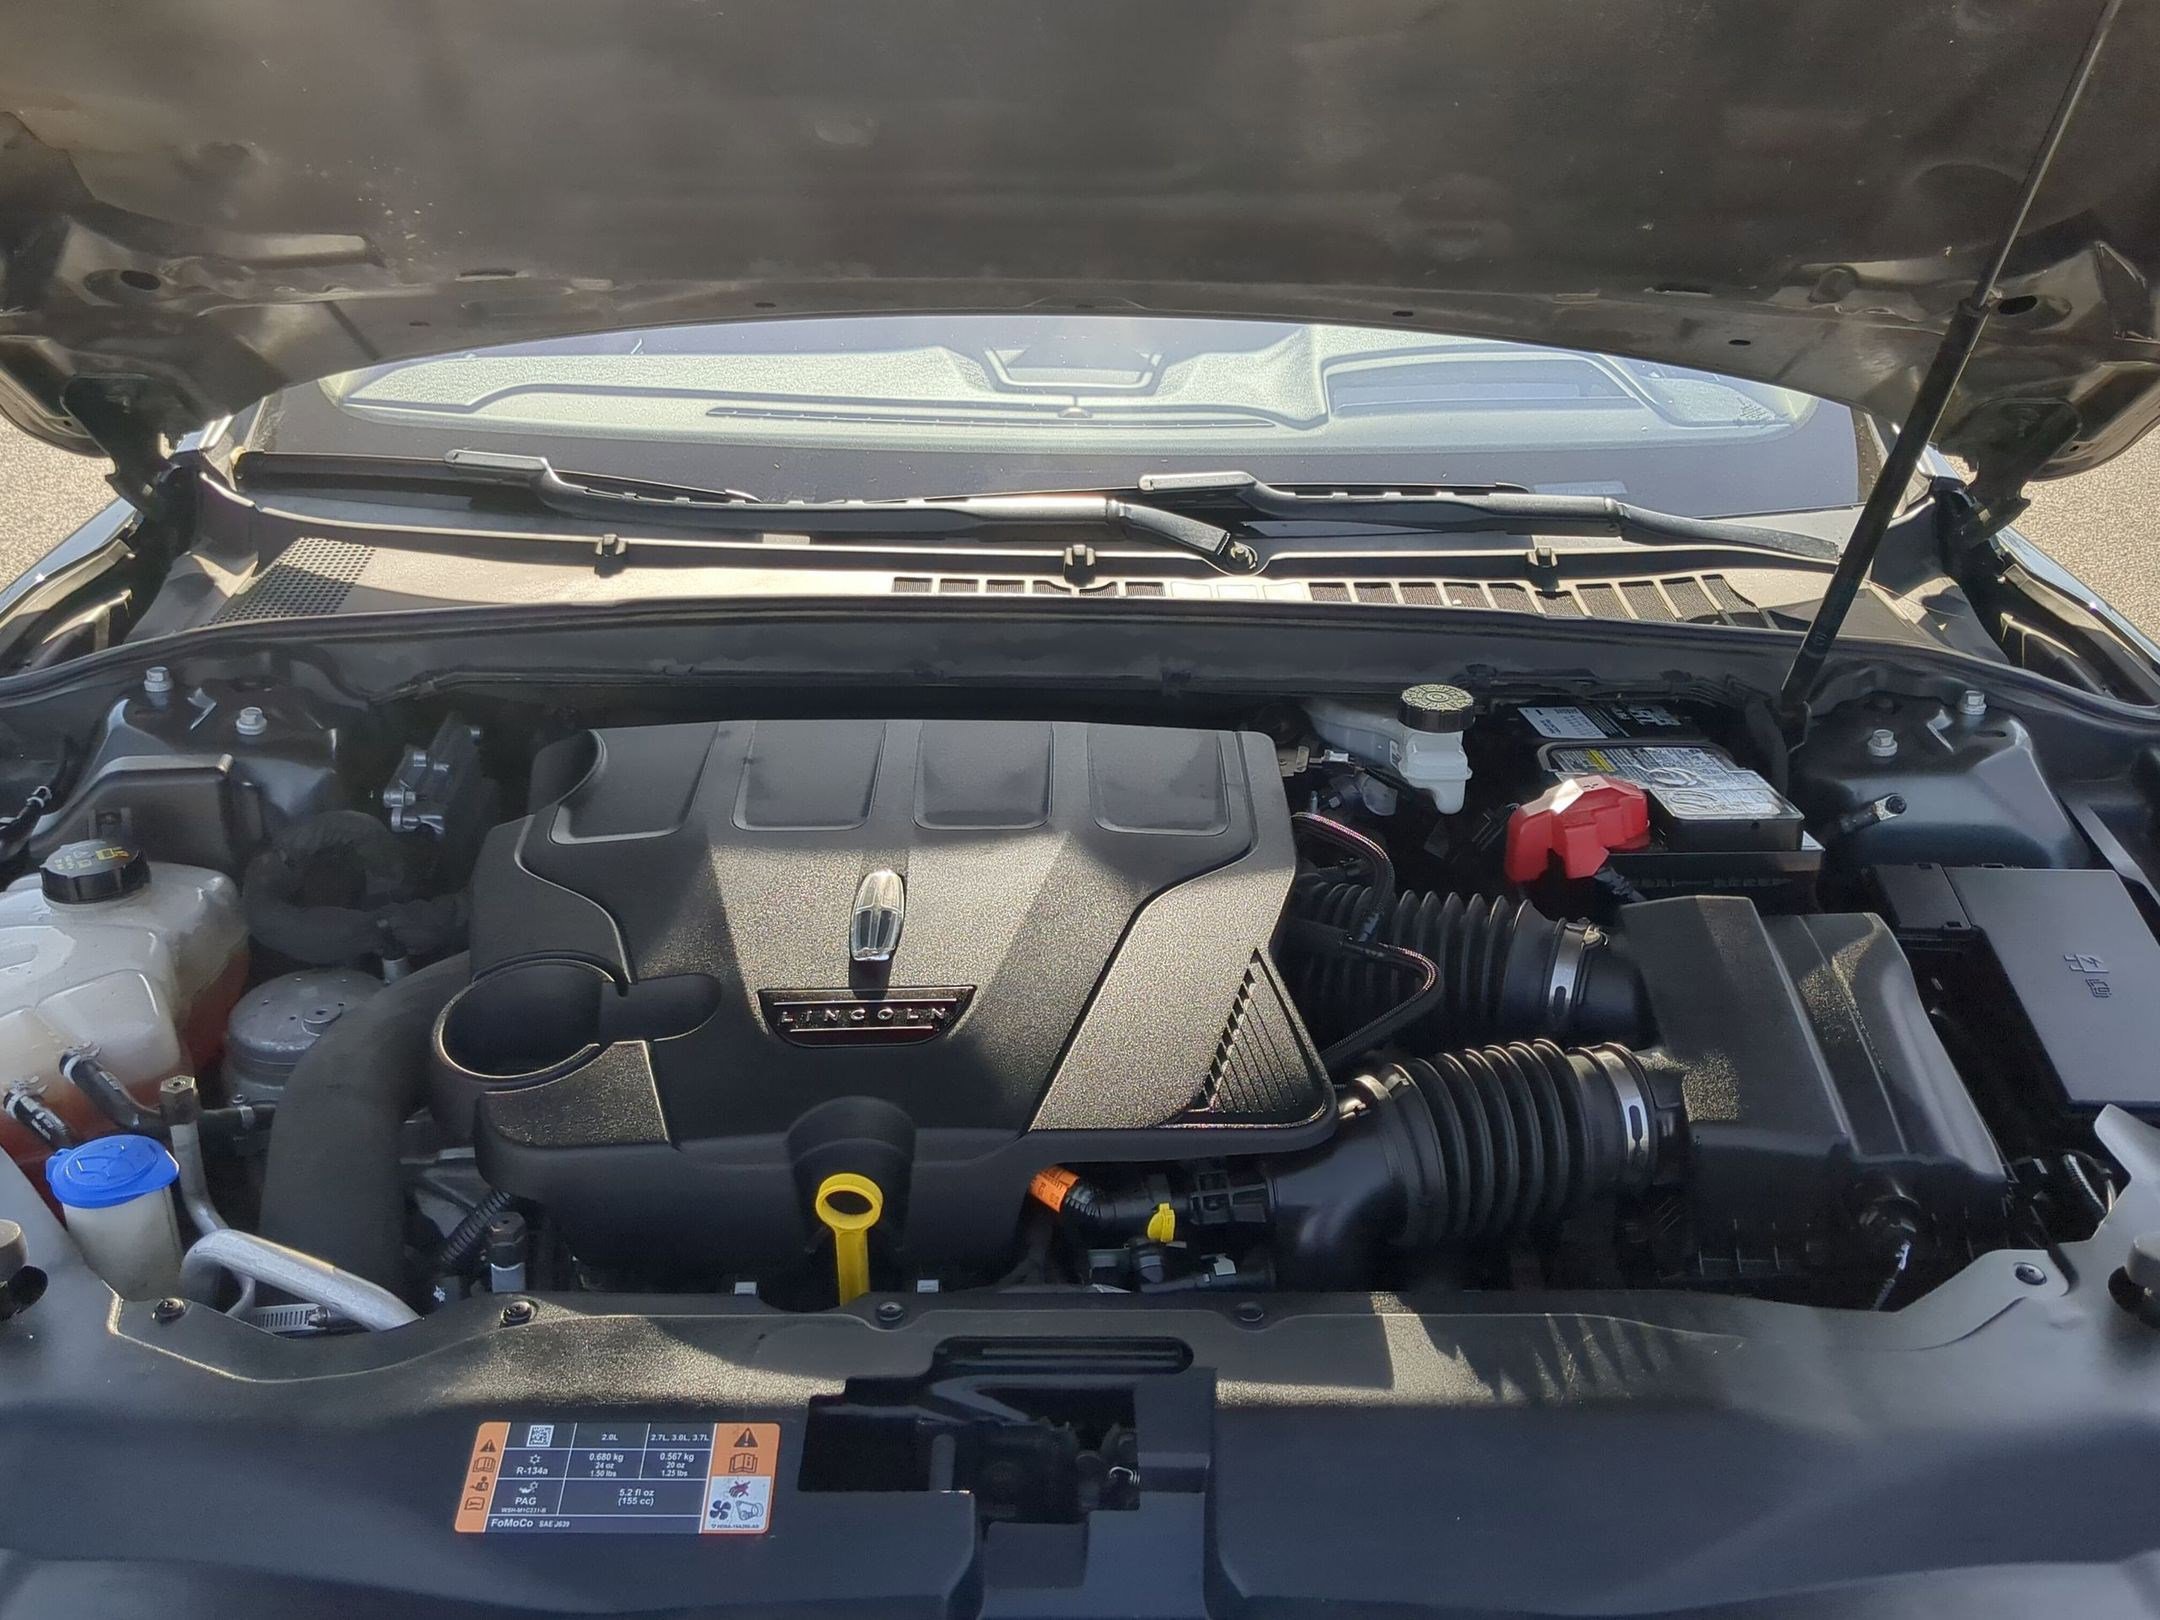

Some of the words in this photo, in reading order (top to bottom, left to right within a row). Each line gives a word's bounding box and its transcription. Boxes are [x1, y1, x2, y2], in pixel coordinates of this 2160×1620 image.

[781, 1007, 946, 1023] LINCOLN
[589, 1453, 611, 1461] 0.680
[613, 1453, 624, 1463] kg
[660, 1452, 682, 1461] 0.567
[683, 1452, 695, 1462] kg
[516, 1466, 548, 1475] R-134a
[619, 1489, 633, 1497] 5.2
[634, 1489, 642, 1497] fl
[515, 1497, 537, 1506] PAG
[617, 1497, 638, 1506] (155
[640, 1497, 654, 1506] cc)
[490, 1518, 534, 1528] FoMoCo
[539, 1520, 553, 1528] SAE
